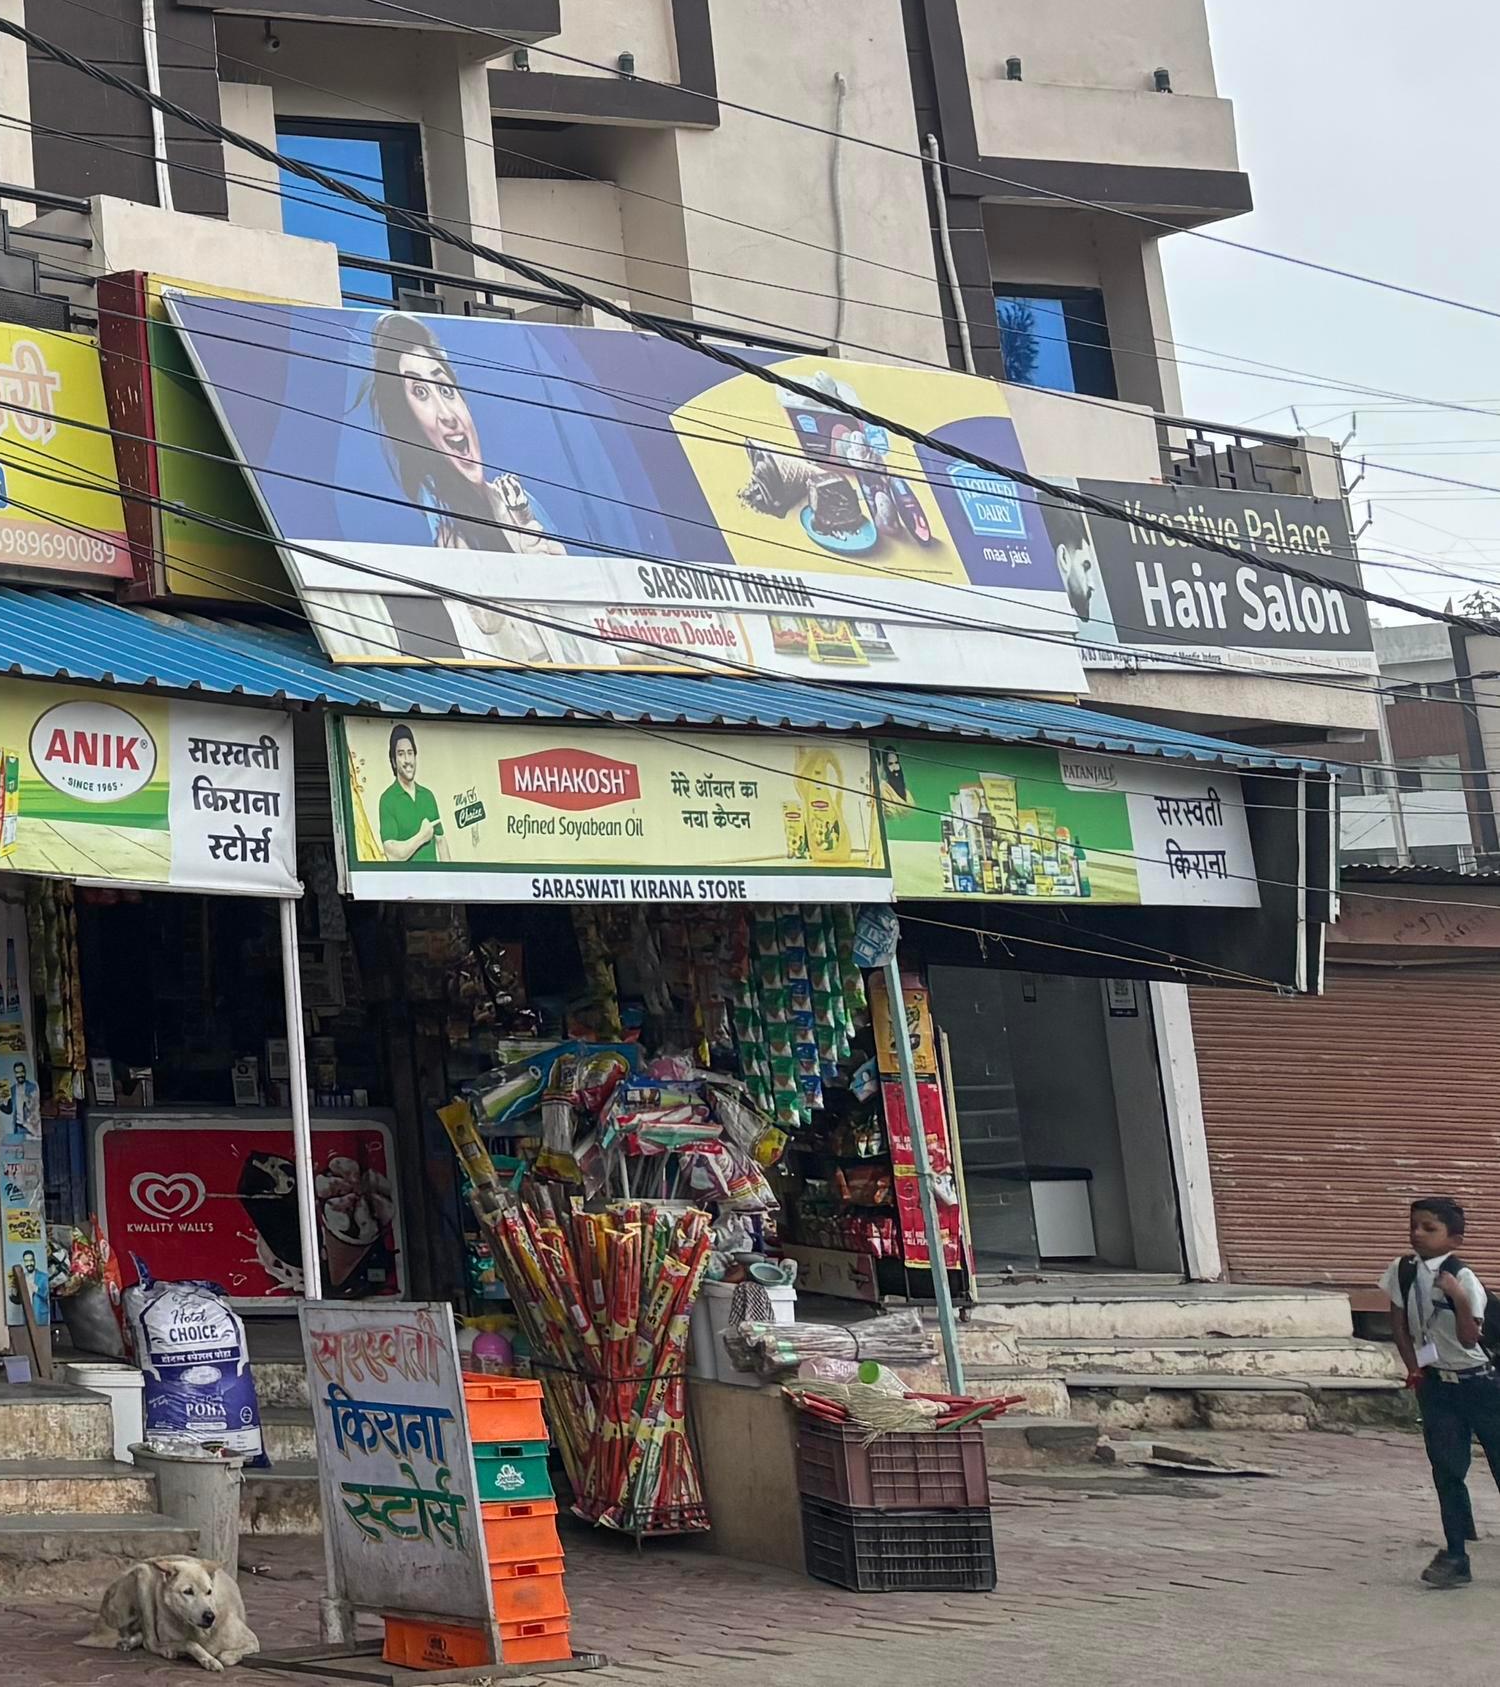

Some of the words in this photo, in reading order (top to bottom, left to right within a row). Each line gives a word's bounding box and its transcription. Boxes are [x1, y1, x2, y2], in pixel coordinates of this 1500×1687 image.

[975, 503, 1013, 523] DAIRY
[1124, 500, 1241, 550] Kreative
[1243, 508, 1333, 557] Palace
[983, 547, 1008, 563] maa
[1007, 544, 1032, 568] jaisi
[637, 565, 739, 602] SARSWATI
[740, 571, 815, 608] KIRANA
[1135, 561, 1227, 629] Hair
[1236, 566, 1351, 635] Salon
[594, 617, 682, 646] Khushiyan
[680, 620, 737, 647] Double
[44, 728, 141, 771] ANIK
[188, 734, 280, 770] सरस्वती
[67, 777, 94, 792] SINCE
[97, 781, 118, 793] 1965
[191, 775, 281, 817] किराना
[514, 765, 625, 794] MAHAKOSH
[670, 771, 690, 799] मेरे
[695, 772, 735, 799] ऑयल
[738, 780, 758, 799] का
[681, 810, 708, 829] नया
[712, 803, 751, 829] कैप्टन
[1153, 786, 1223, 826] सरस्वती
[208, 824, 273, 863] स्टोर्स
[507, 814, 555, 840] Refined
[558, 816, 622, 841] Soyabean
[625, 817, 644, 837] Oil
[1166, 838, 1229, 879] किराना
[532, 878, 627, 899] SARASWATI
[630, 879, 694, 899] KIRANA
[699, 879, 747, 899] STORE
[127, 1223, 173, 1232] KWALITY
[178, 1222, 214, 1232] WALL'S
[171, 1308, 207, 1324] Hotel
[169, 1325, 219, 1342] CHOICE
[309, 1309, 447, 1387] सरस्वती
[323, 1382, 455, 1465] किराना
[340, 1463, 467, 1552] स्टोर्स
